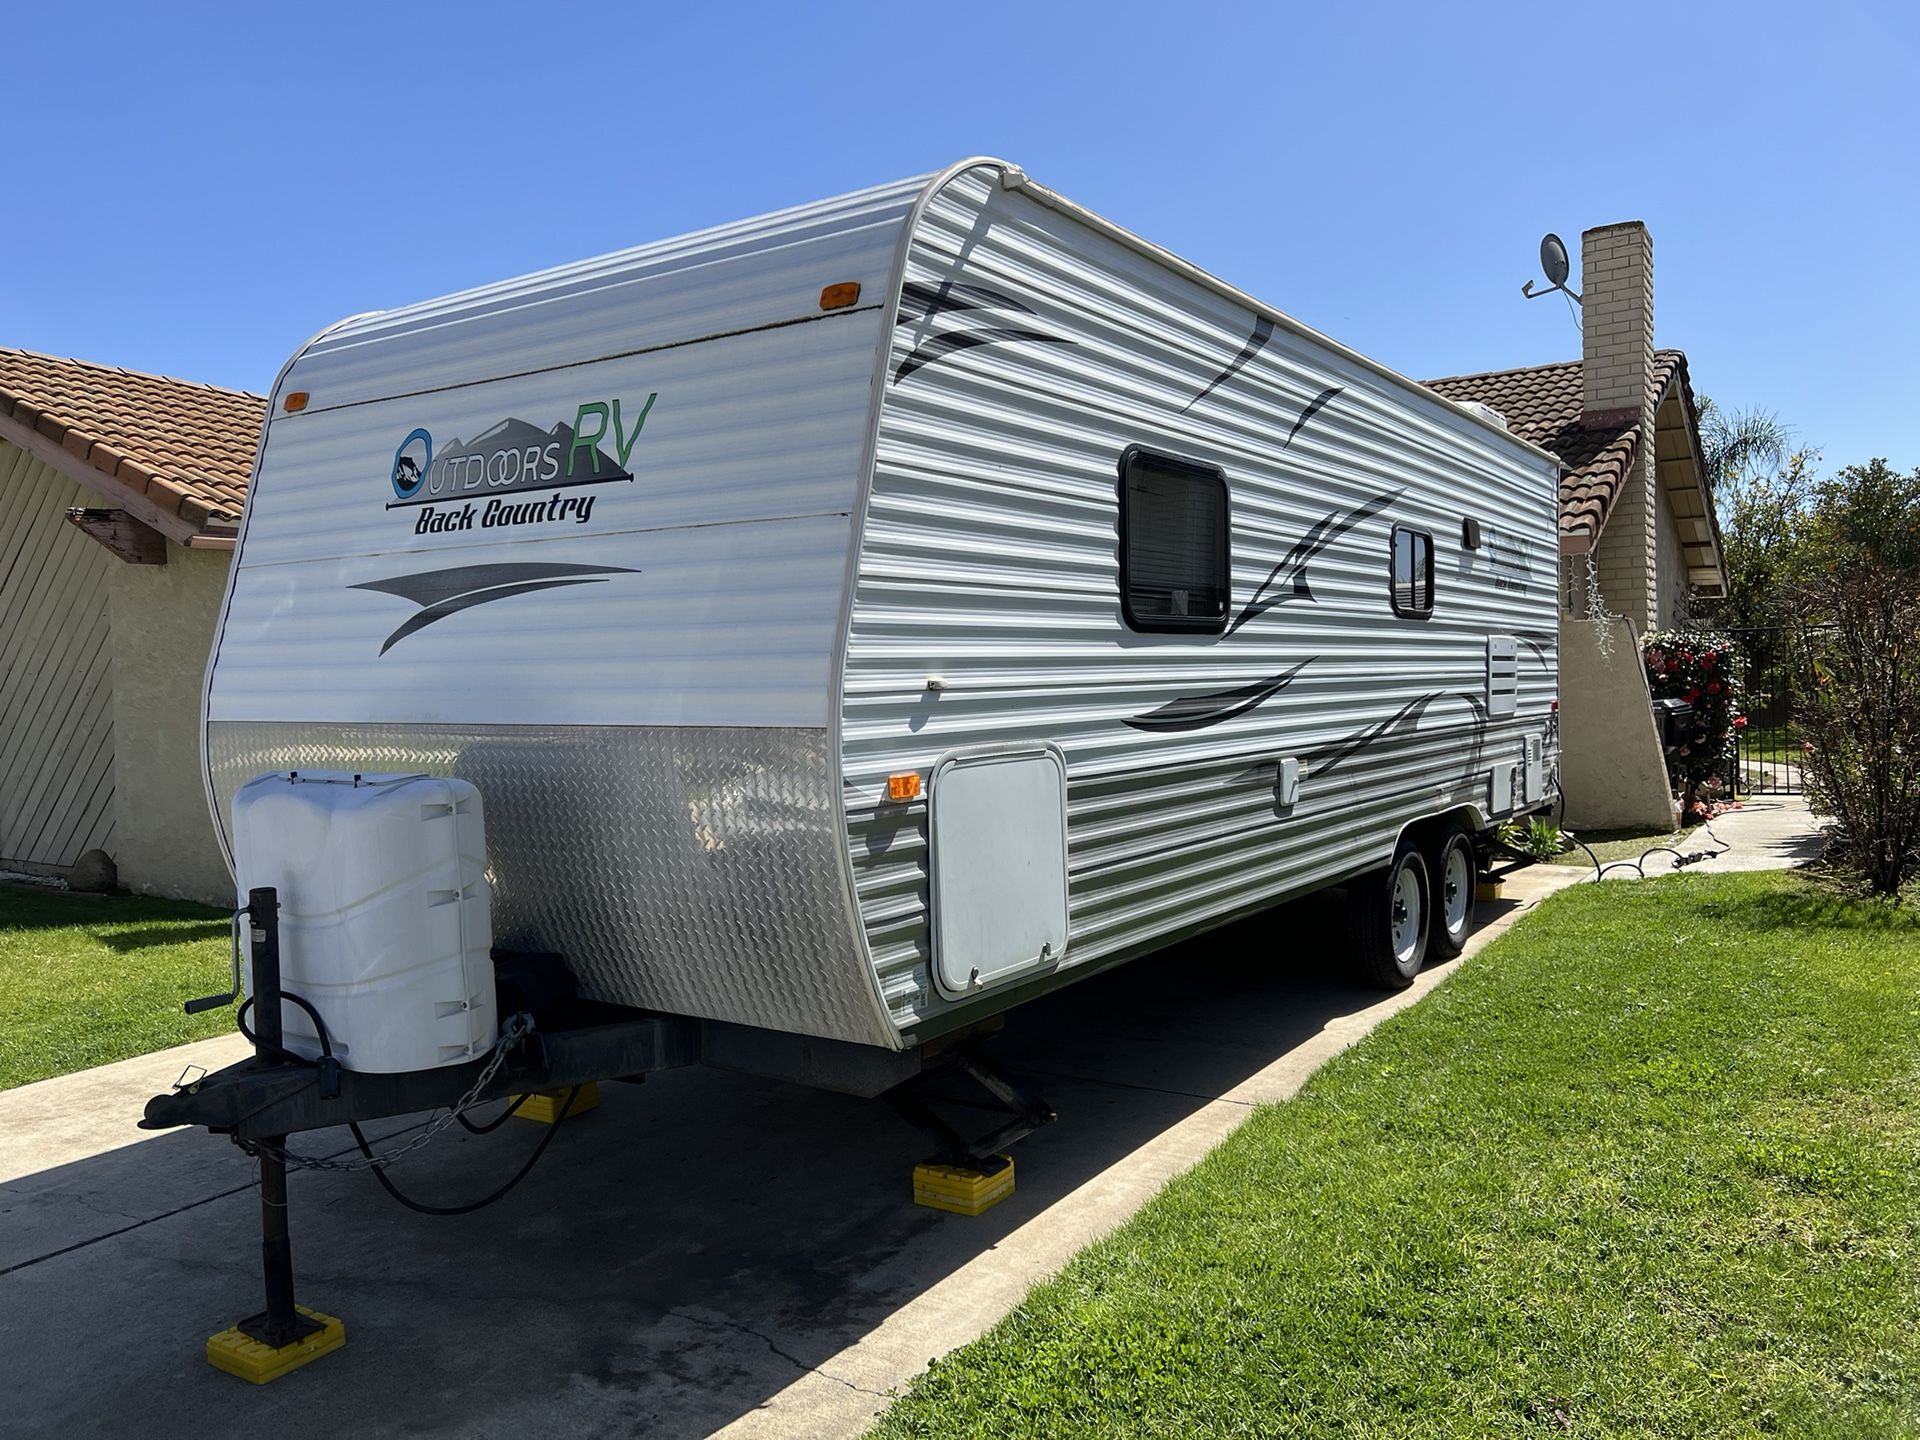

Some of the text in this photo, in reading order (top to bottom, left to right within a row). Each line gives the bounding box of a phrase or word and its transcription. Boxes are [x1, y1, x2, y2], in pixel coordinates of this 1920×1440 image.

[391, 393, 657, 499] OUTDOORS RV
[415, 493, 596, 535] Back Country
